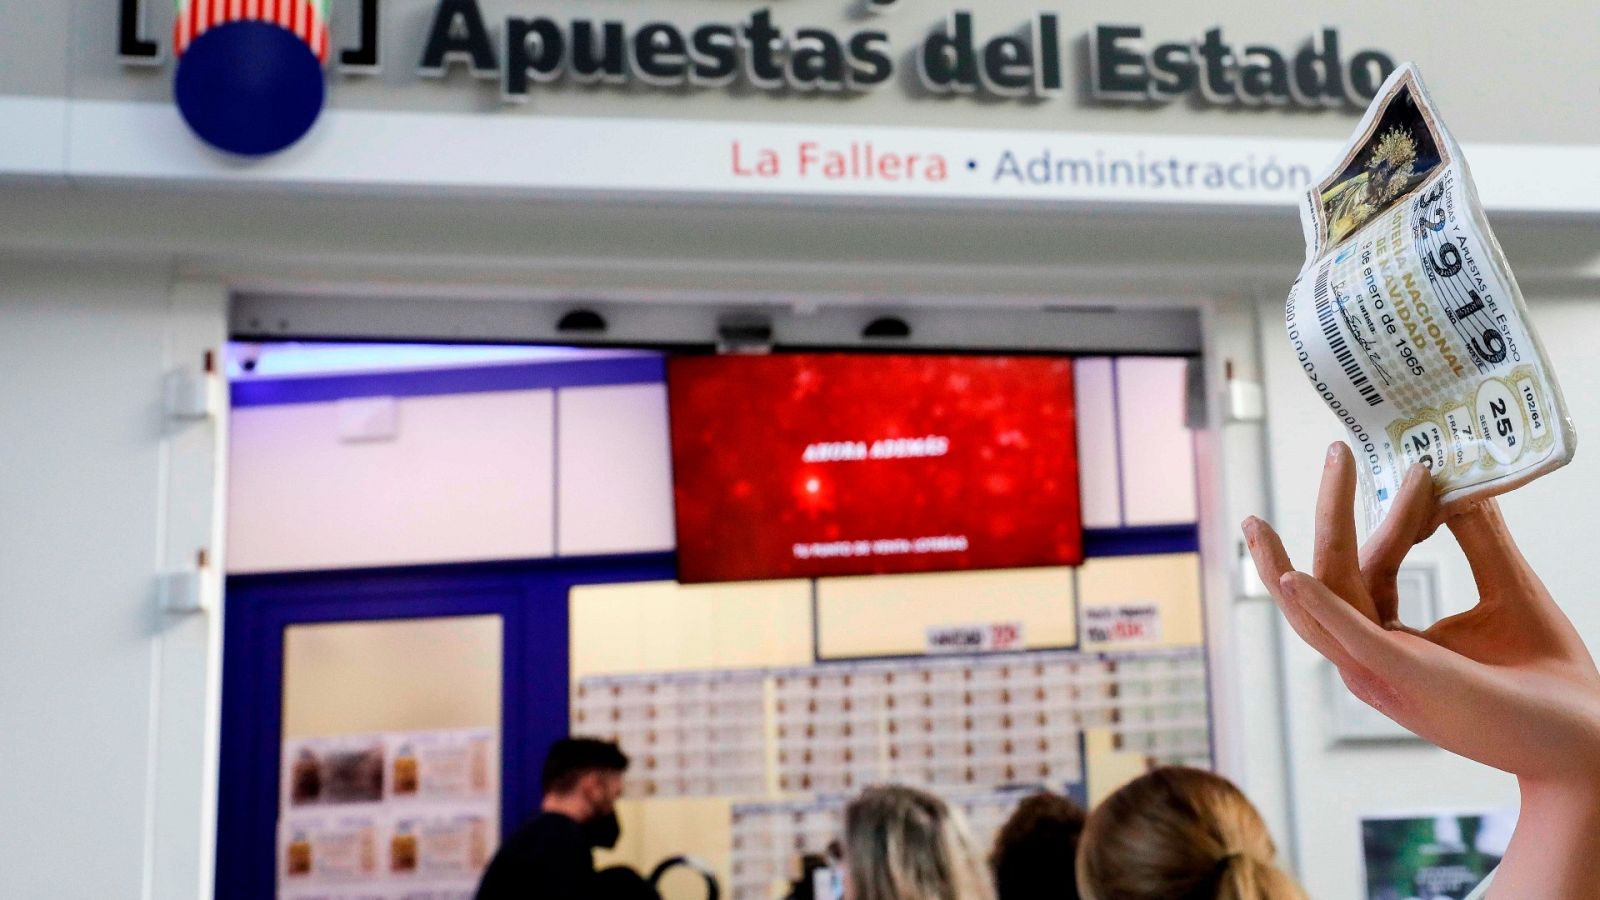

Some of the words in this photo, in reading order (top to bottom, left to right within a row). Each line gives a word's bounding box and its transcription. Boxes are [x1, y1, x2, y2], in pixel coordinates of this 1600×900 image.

[420, 0, 894, 98] Apuestas
[921, 12, 1061, 93] del
[1096, 24, 1397, 102] Estado
[731, 140, 780, 177] La
[799, 142, 948, 181] Fallera
[992, 150, 1313, 191] Administración
[1361, 250, 1371, 265] de
[1363, 267, 1385, 310] enero
[1378, 258, 1427, 350] NAVIDAD
[1381, 313, 1397, 335] de
[1402, 272, 1464, 377] NACIONAL
[1484, 294, 1498, 314] DEL
[1496, 313, 1521, 362] ESTADO
[1395, 338, 1426, 376] 1965
[1479, 414, 1492, 441] SERIE
[1523, 385, 1542, 430] 102/64
[1431, 428, 1444, 468] PRECIO
